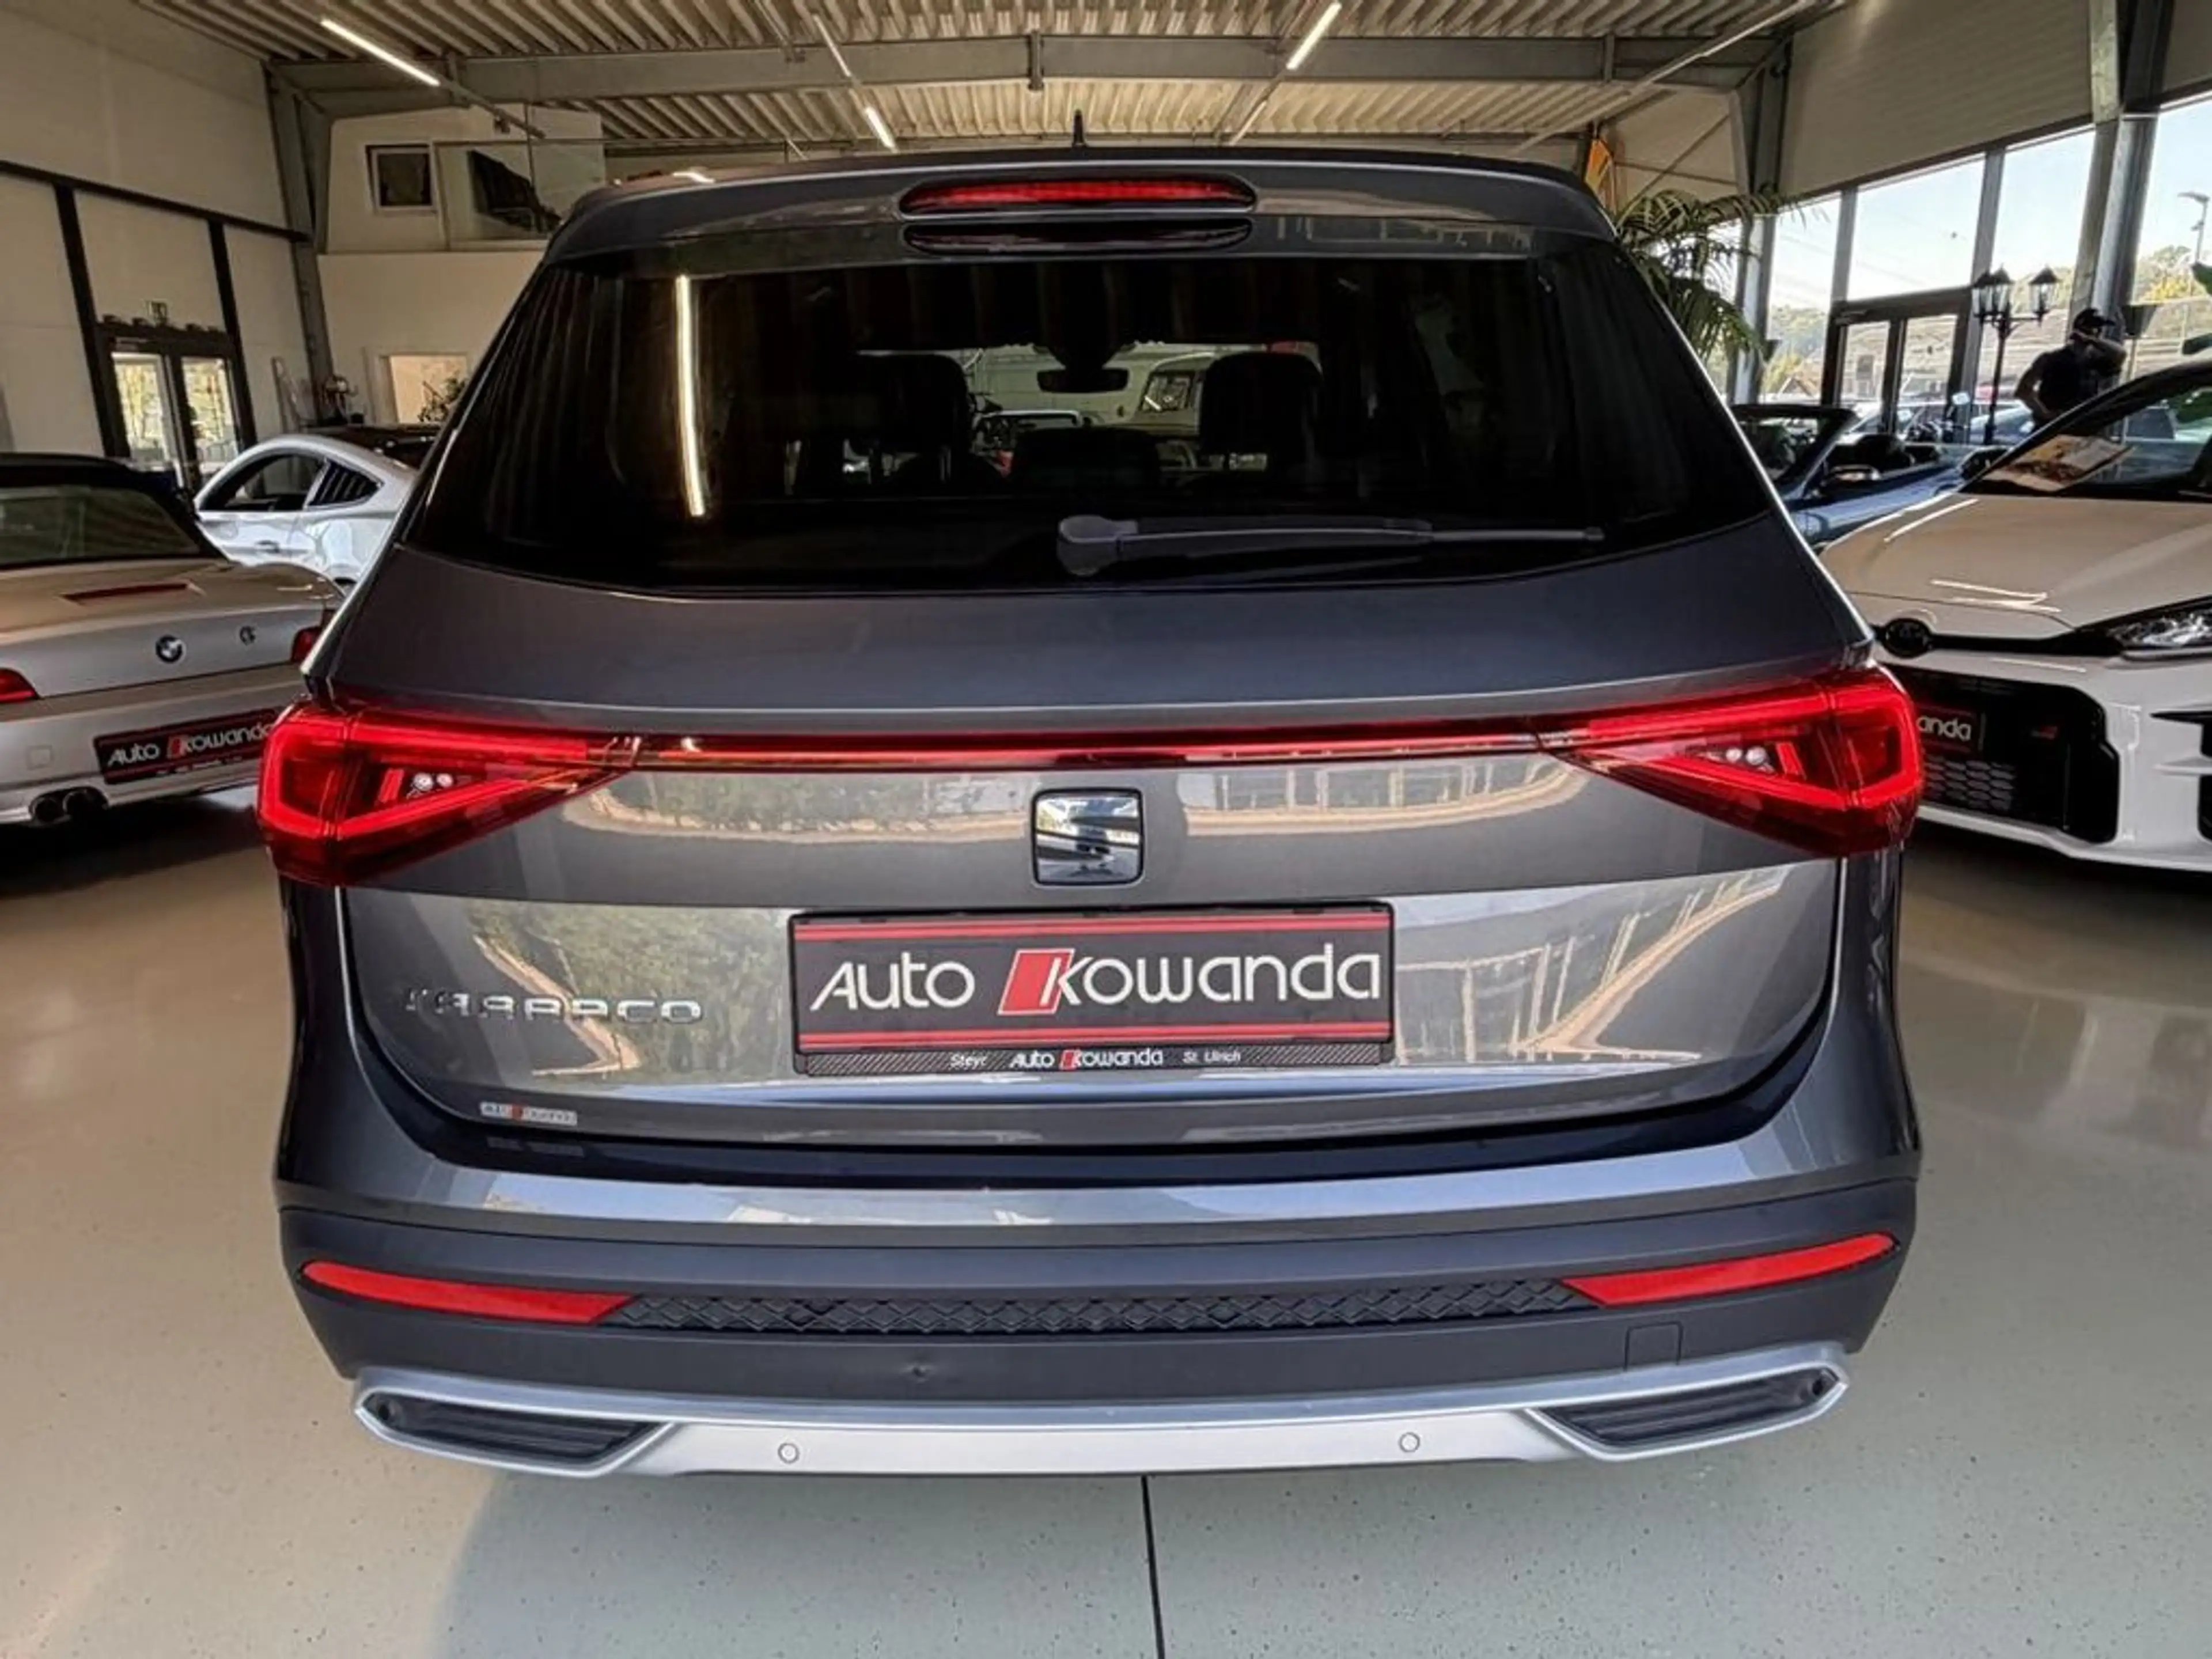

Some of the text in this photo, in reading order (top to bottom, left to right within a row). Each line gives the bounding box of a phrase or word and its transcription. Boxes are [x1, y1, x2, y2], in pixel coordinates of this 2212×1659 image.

[1916, 715, 1971, 742] anda
[107, 743, 160, 767] Auto
[810, 943, 1381, 1011] Auto Kowanda
[950, 1053, 988, 1070] Steyr
[1009, 1051, 1055, 1069] Auto
[1073, 1048, 1164, 1070] Kowanda
[1204, 1050, 1241, 1063] Ulrich
